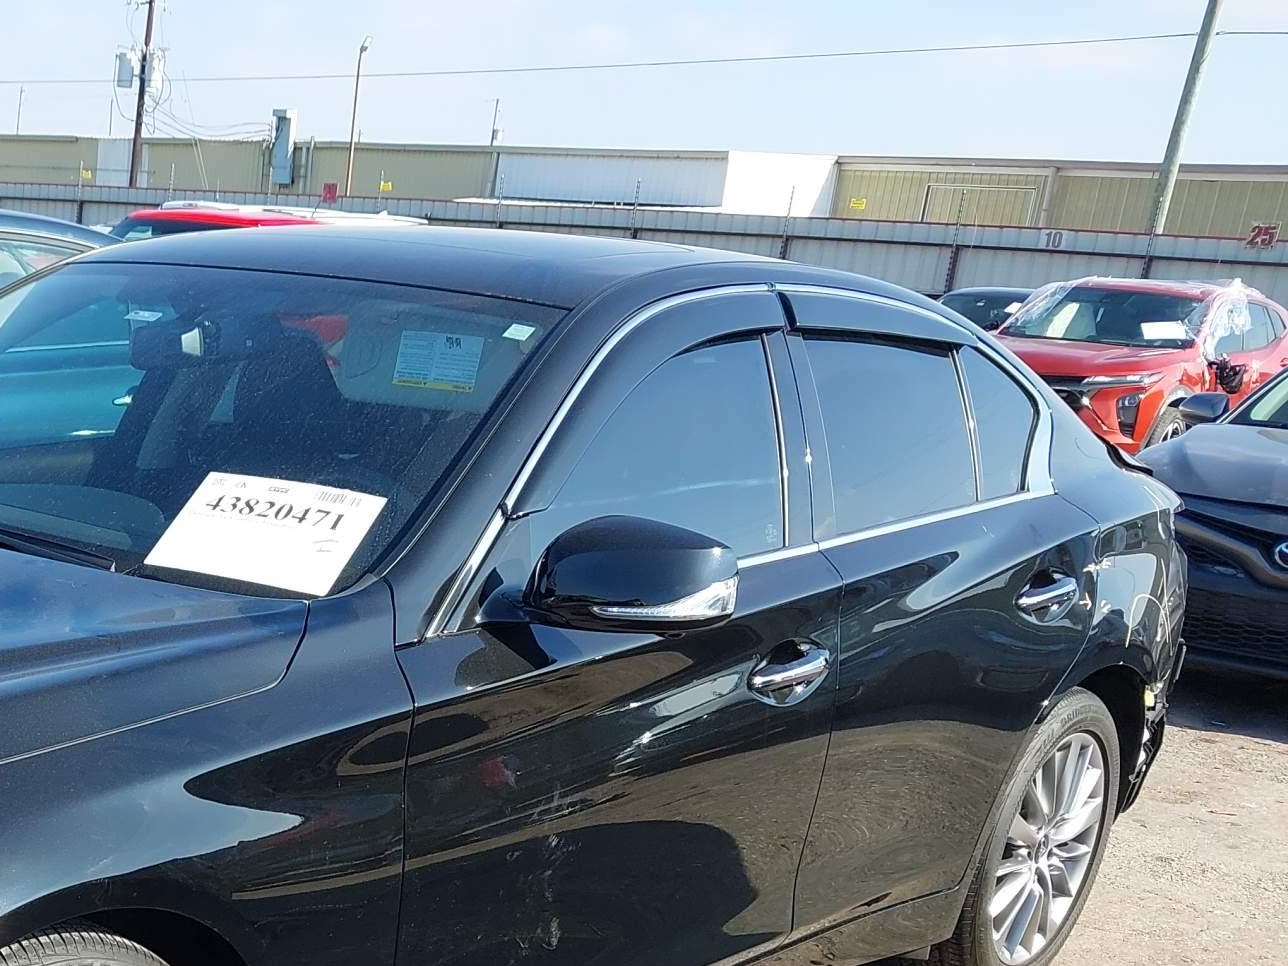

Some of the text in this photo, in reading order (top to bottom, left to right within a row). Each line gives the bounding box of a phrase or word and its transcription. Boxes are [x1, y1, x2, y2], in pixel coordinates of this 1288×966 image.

[1044, 230, 1064, 249] 10
[1246, 223, 1280, 249] 25
[205, 494, 345, 531] 43820471
